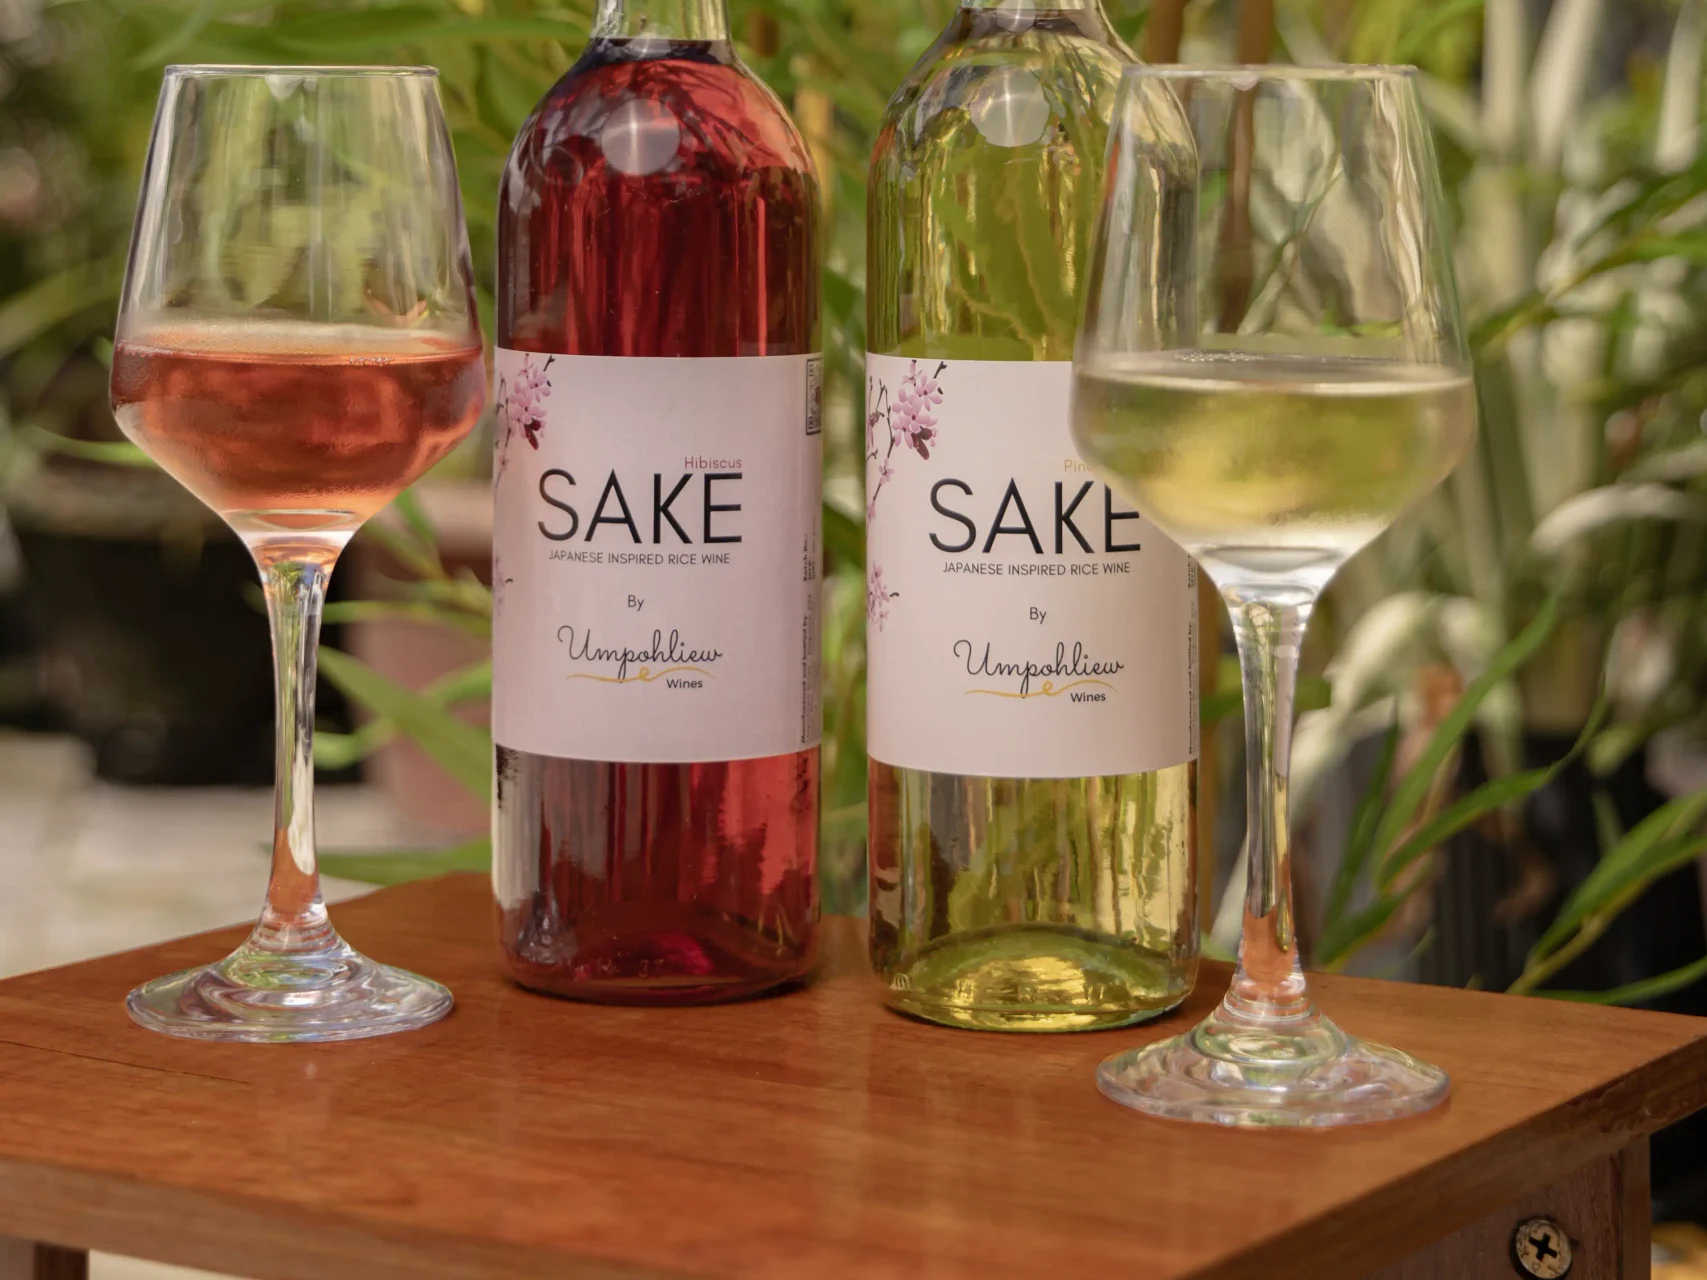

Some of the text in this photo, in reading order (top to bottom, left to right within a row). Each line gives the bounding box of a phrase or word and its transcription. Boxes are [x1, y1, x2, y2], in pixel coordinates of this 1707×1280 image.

[684, 455, 743, 470] Hibiscus
[537, 468, 743, 545] SAKE
[928, 476, 1142, 556] SAKE
[549, 549, 731, 566] JAPANESE INSPIRED RICE WINE
[942, 561, 1131, 577] JAPANESE INSPIRED RICE WINE
[627, 594, 645, 612] By
[1029, 607, 1048, 625] By
[556, 624, 723, 684] Umpohliew
[952, 638, 1125, 699] Umpohliew
[666, 677, 704, 690] Wines
[1069, 690, 1106, 703] Wines
